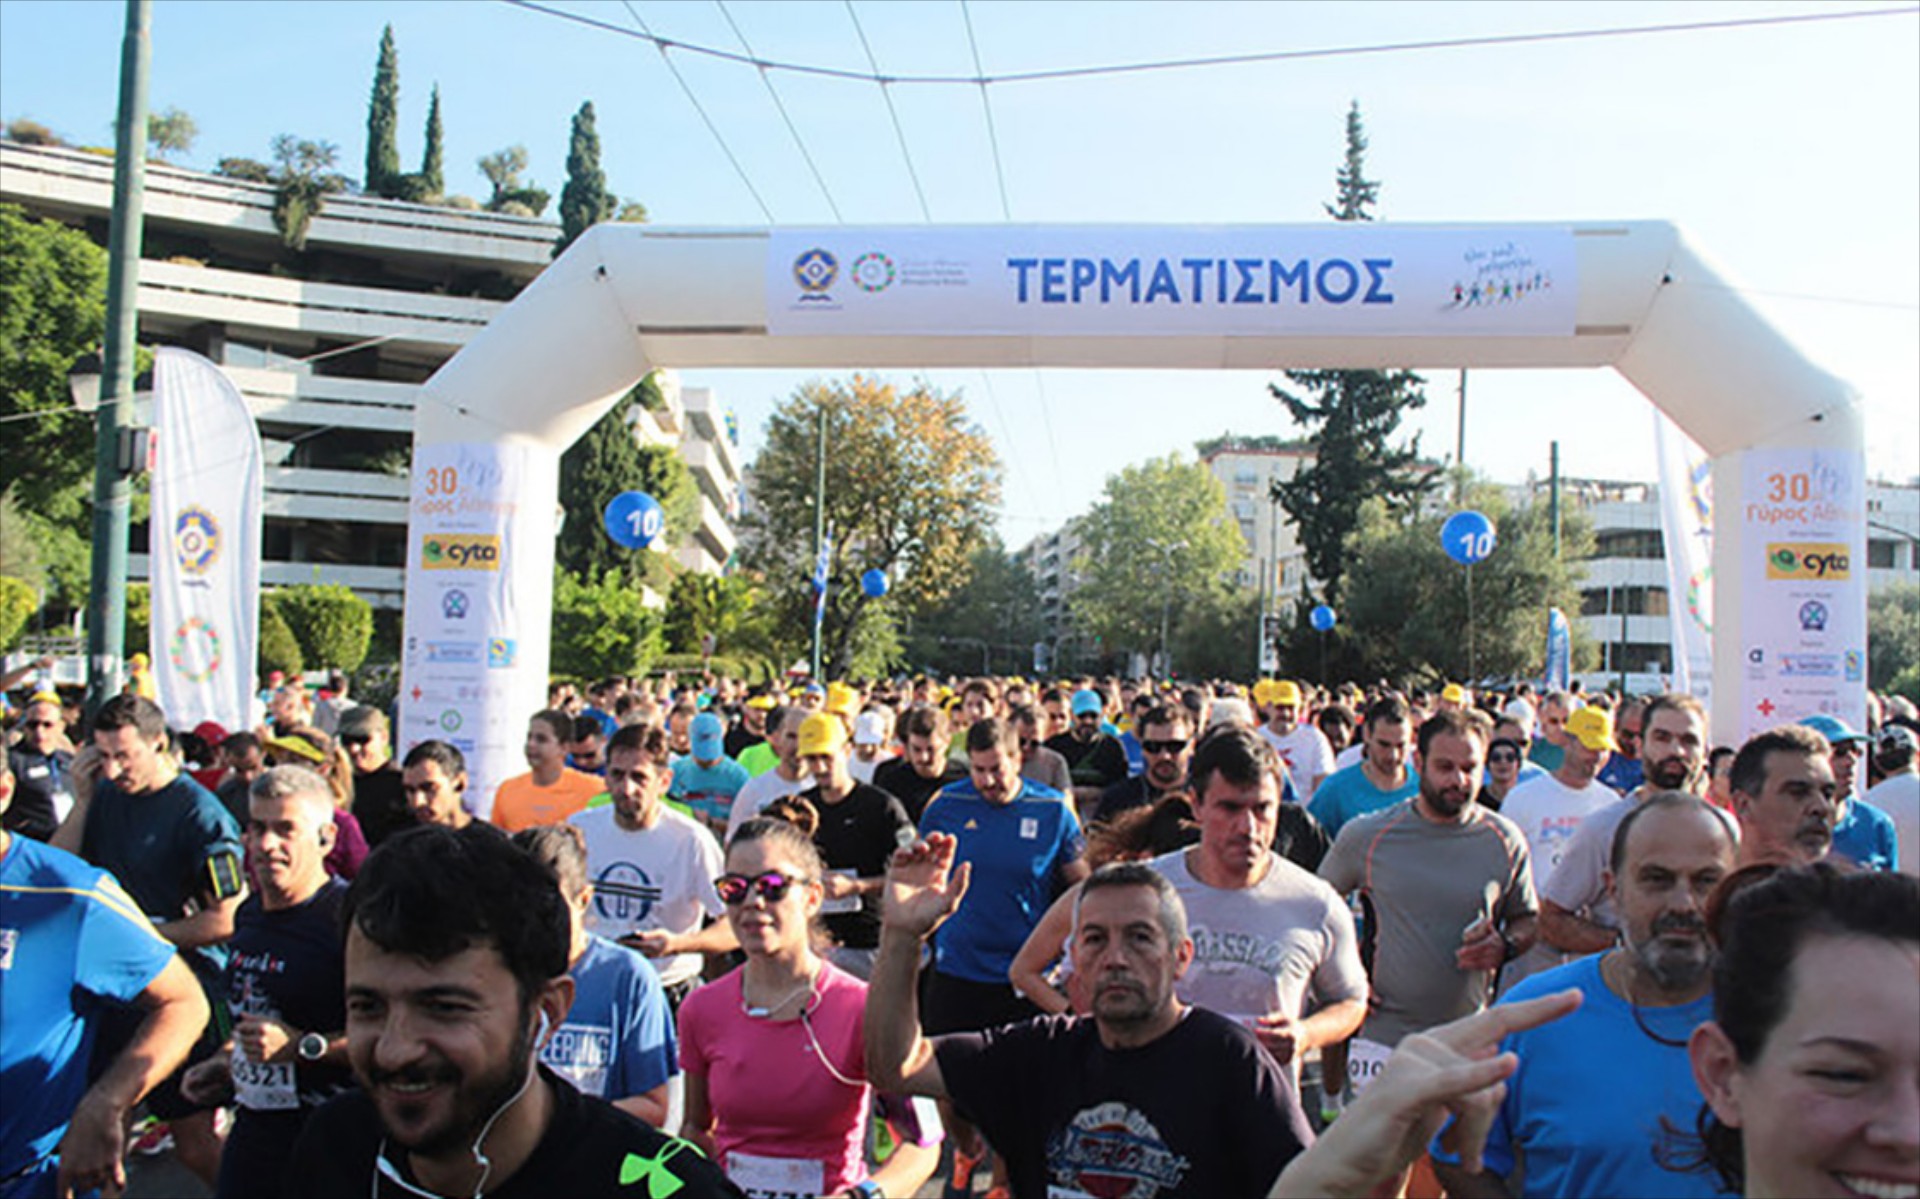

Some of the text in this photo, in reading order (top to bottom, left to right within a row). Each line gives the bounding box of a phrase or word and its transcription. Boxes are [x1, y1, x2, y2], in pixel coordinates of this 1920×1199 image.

[1007, 257, 1395, 304] ΤΕΡΜΑΤΙΣΜΟΣ
[425, 466, 457, 496] 30
[1767, 473, 1810, 503] 30
[626, 508, 659, 537] 10
[1746, 502, 1809, 525] Γύρος
[447, 543, 497, 566] cyta
[1460, 532, 1494, 558] 10
